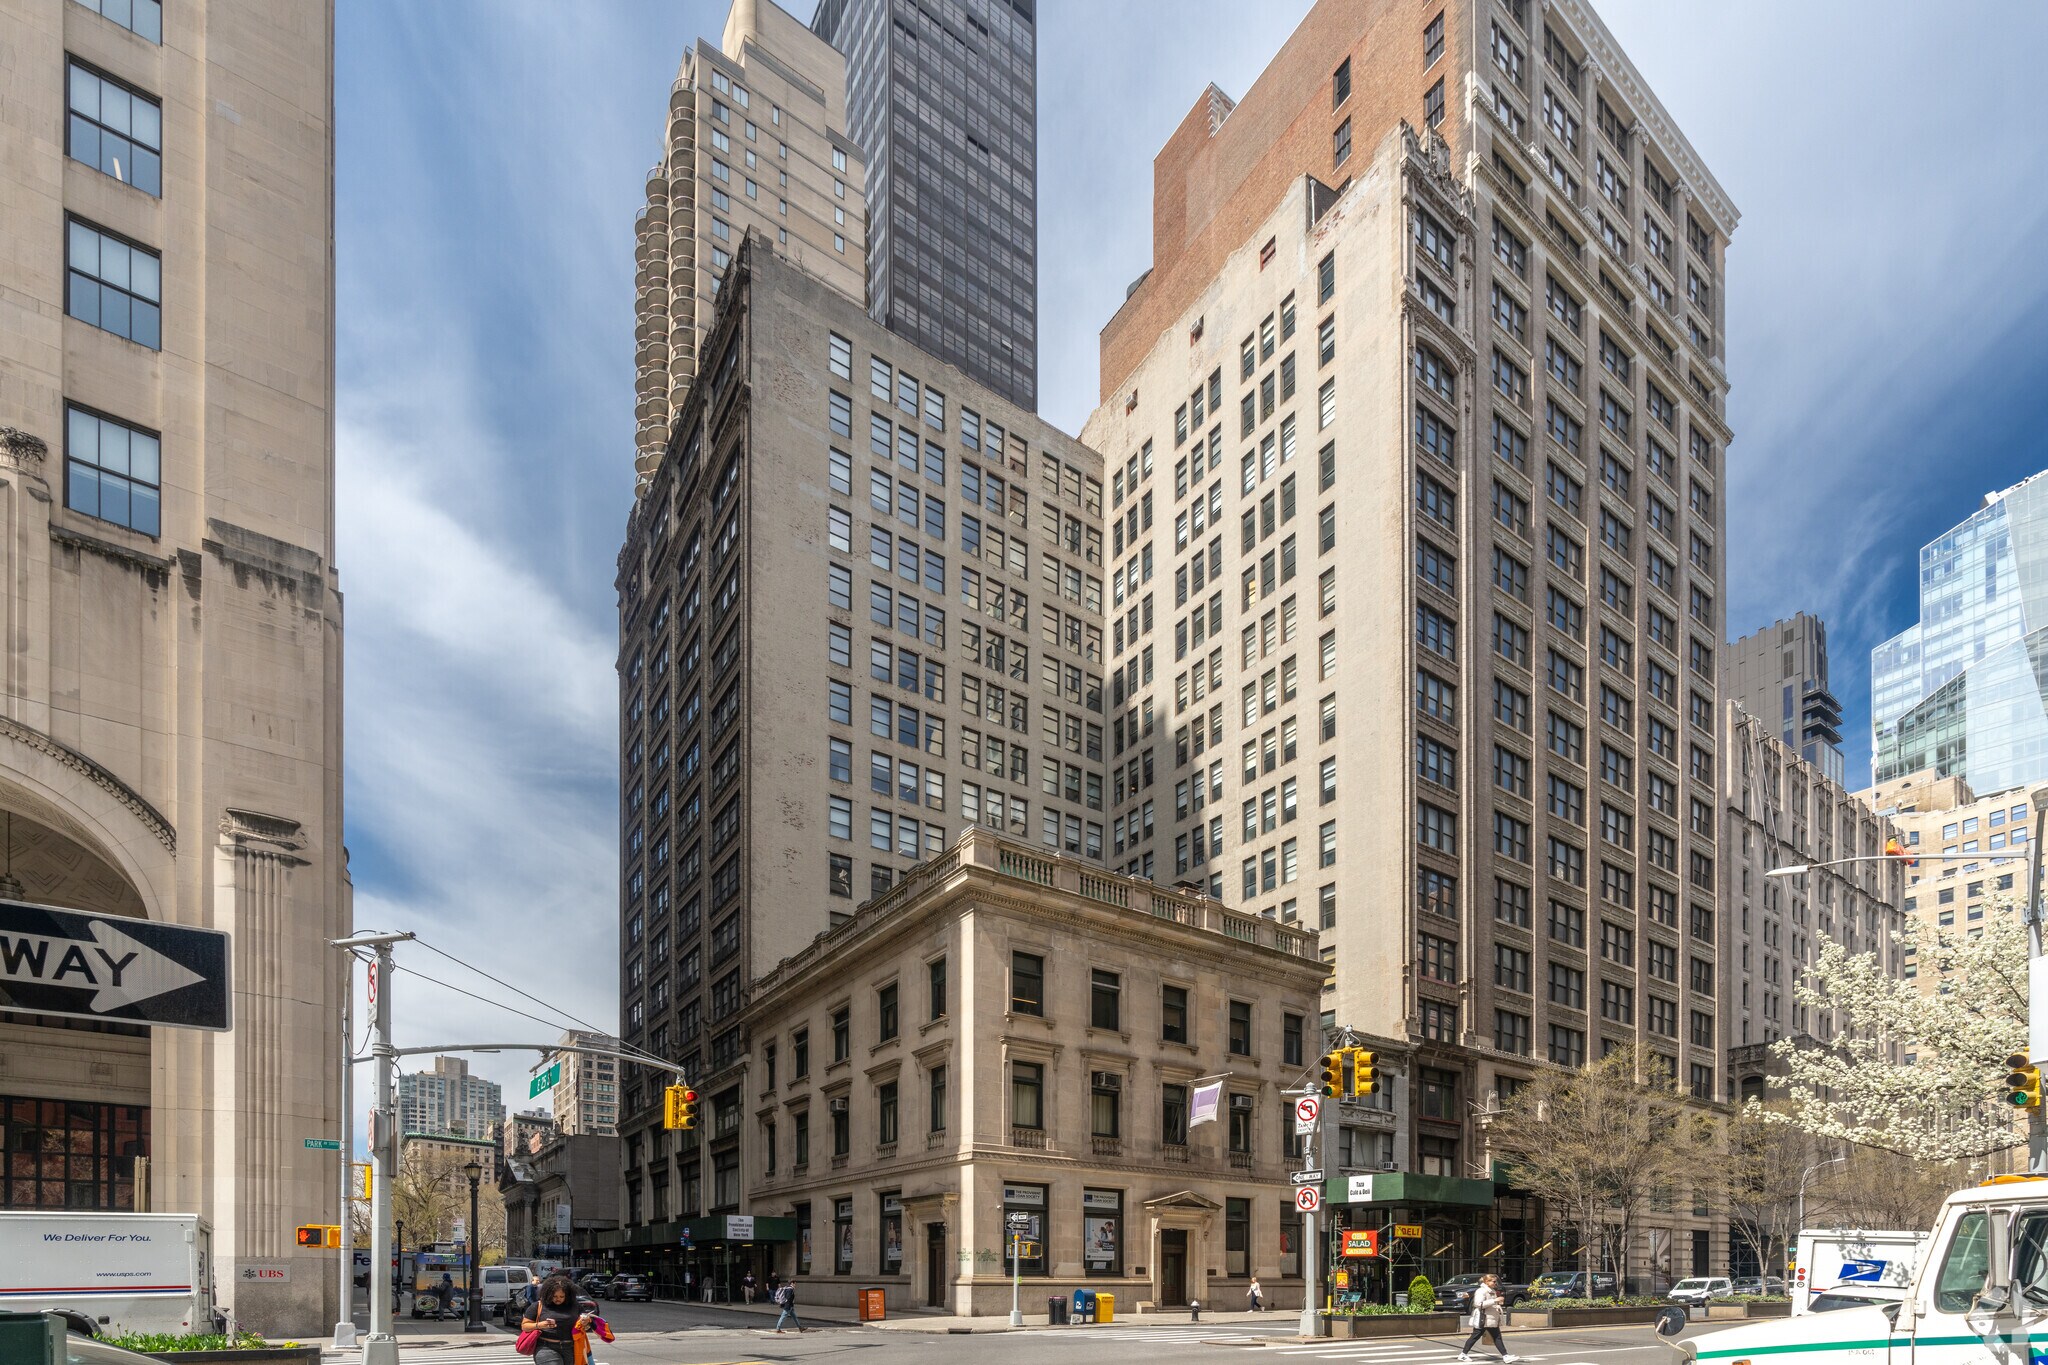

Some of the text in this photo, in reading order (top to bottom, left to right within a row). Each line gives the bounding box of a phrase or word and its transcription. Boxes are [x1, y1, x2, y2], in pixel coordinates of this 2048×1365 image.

[0, 936, 138, 987] WAY
[306, 1140, 323, 1148] PARK
[1401, 1227, 1419, 1236] DELI
[43, 1234, 152, 1242] We Deliver For You.
[1348, 1240, 1371, 1248] SALAD
[259, 1269, 284, 1278] UBS
